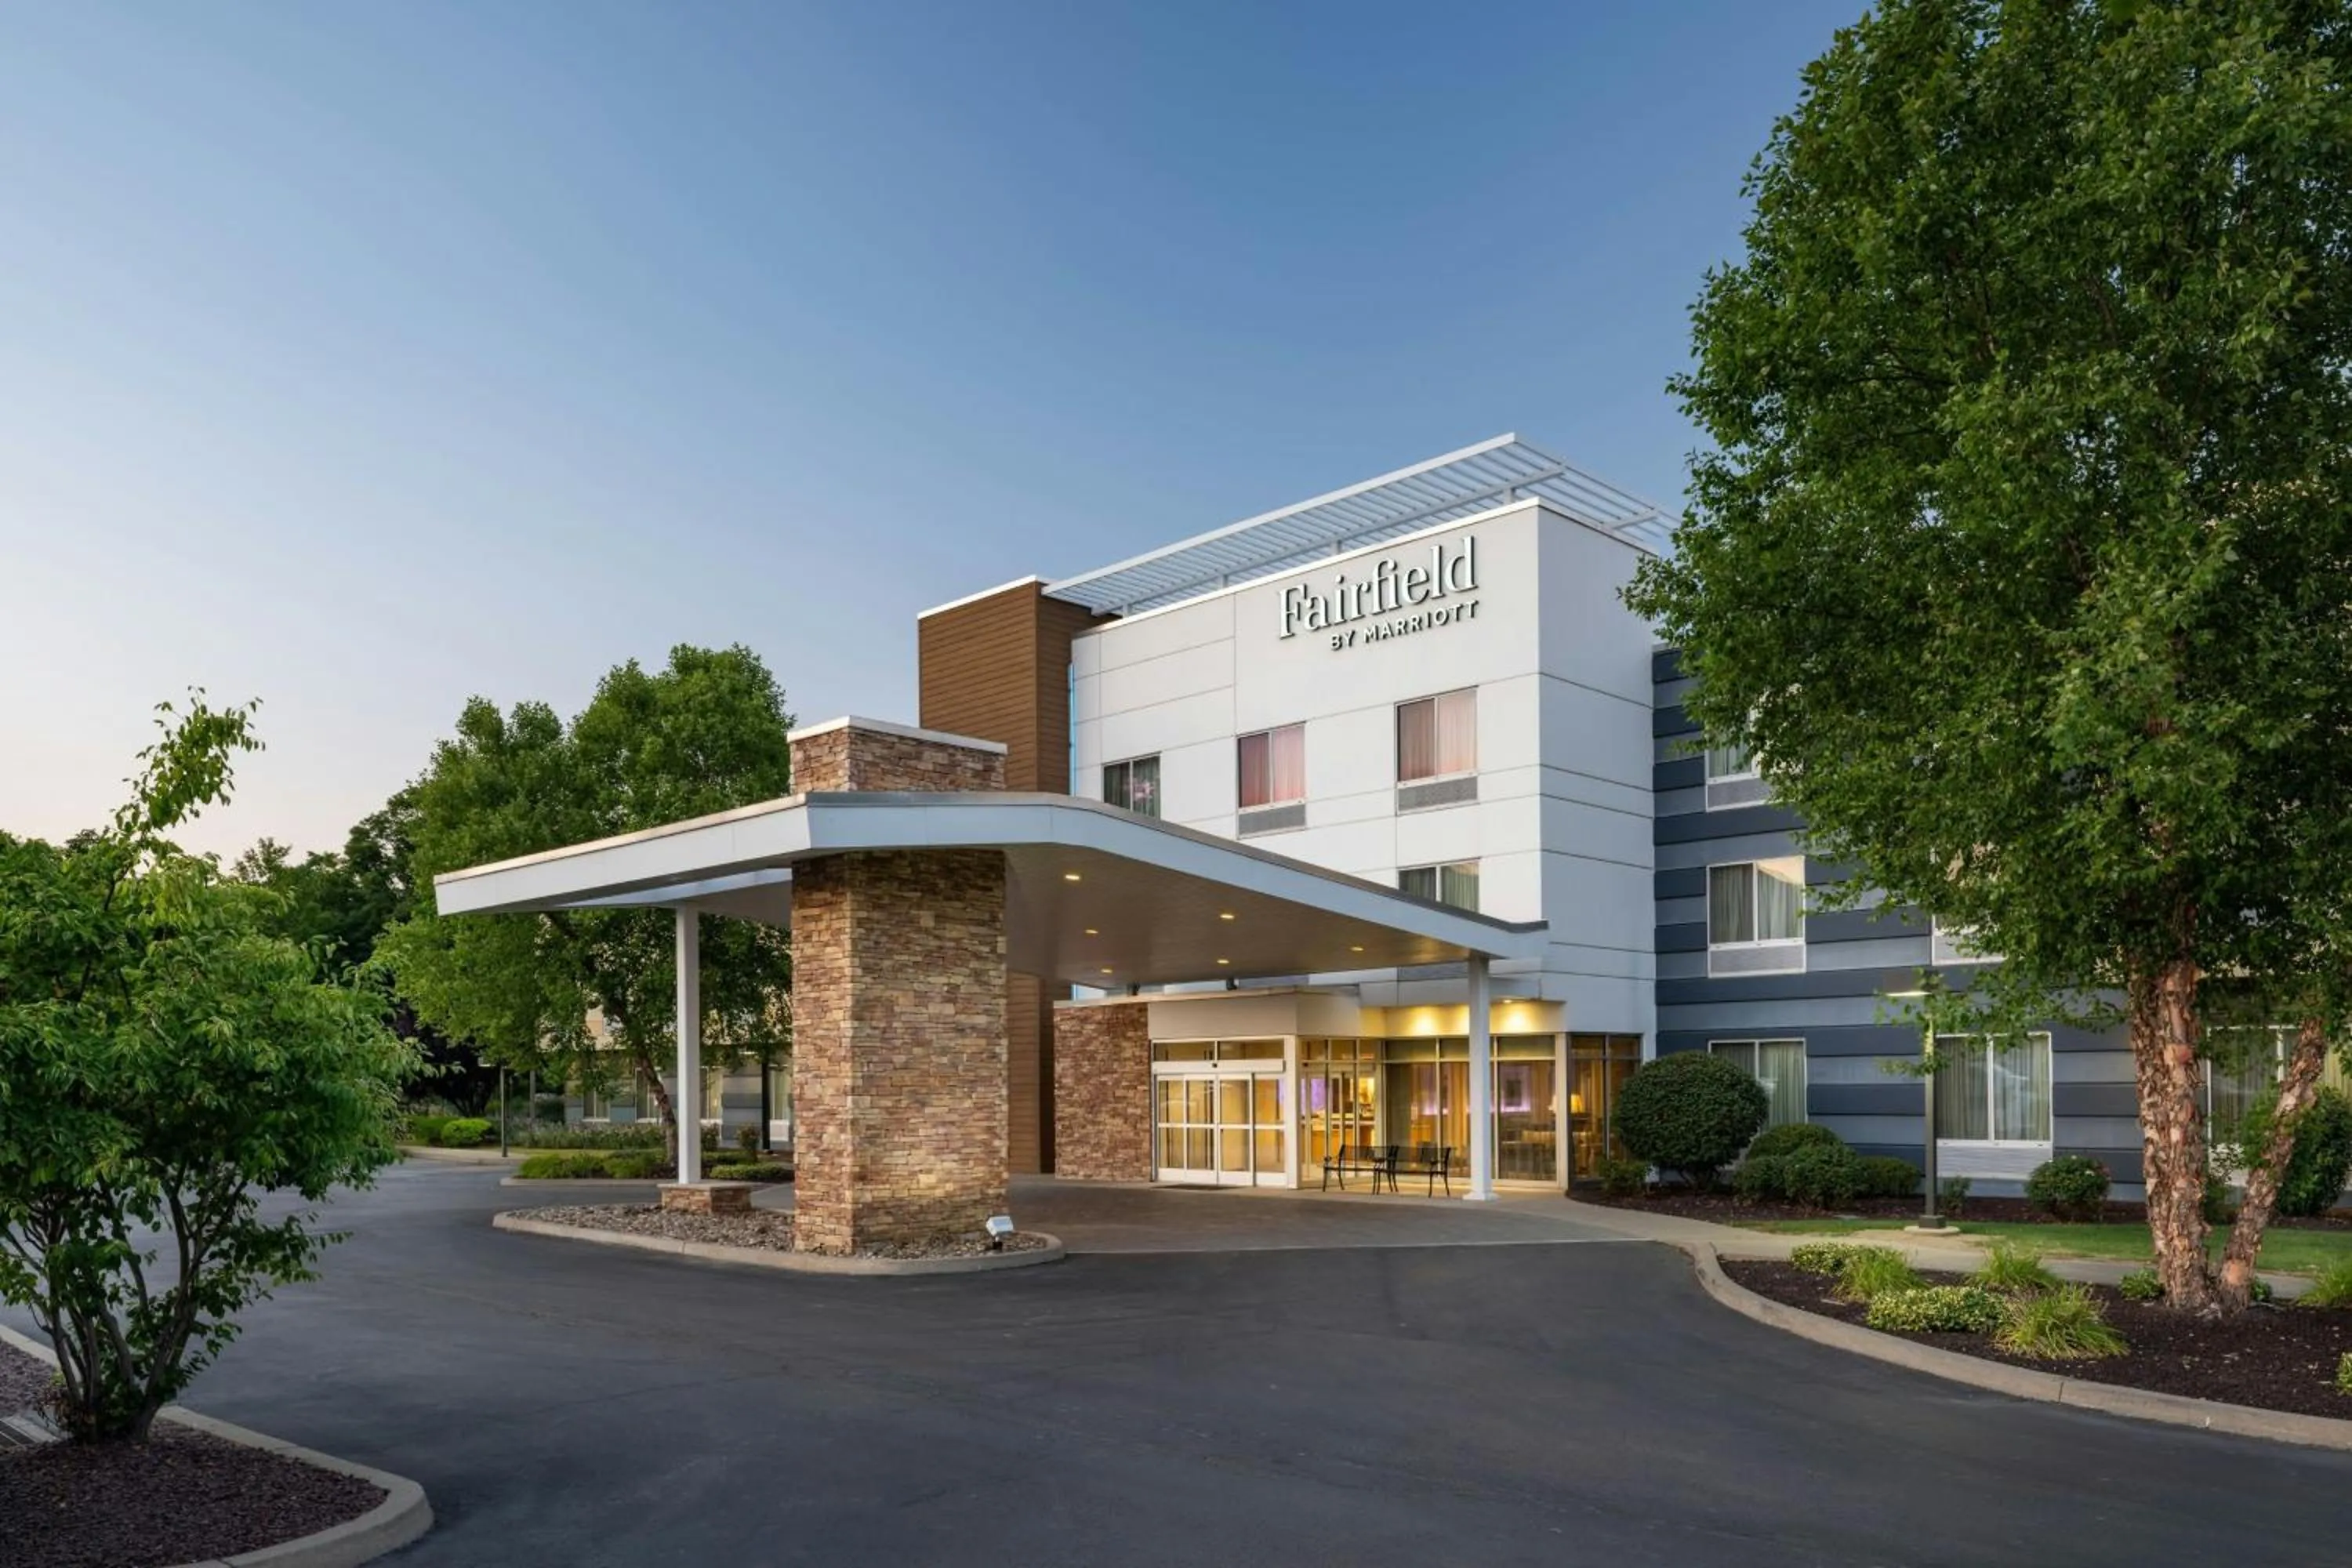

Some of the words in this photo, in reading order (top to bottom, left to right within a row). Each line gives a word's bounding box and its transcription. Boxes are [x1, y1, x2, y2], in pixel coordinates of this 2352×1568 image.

[1278, 535, 1479, 639] Fairfield
[1330, 630, 1356, 651] BY
[1363, 600, 1479, 644] MARRIOTT
